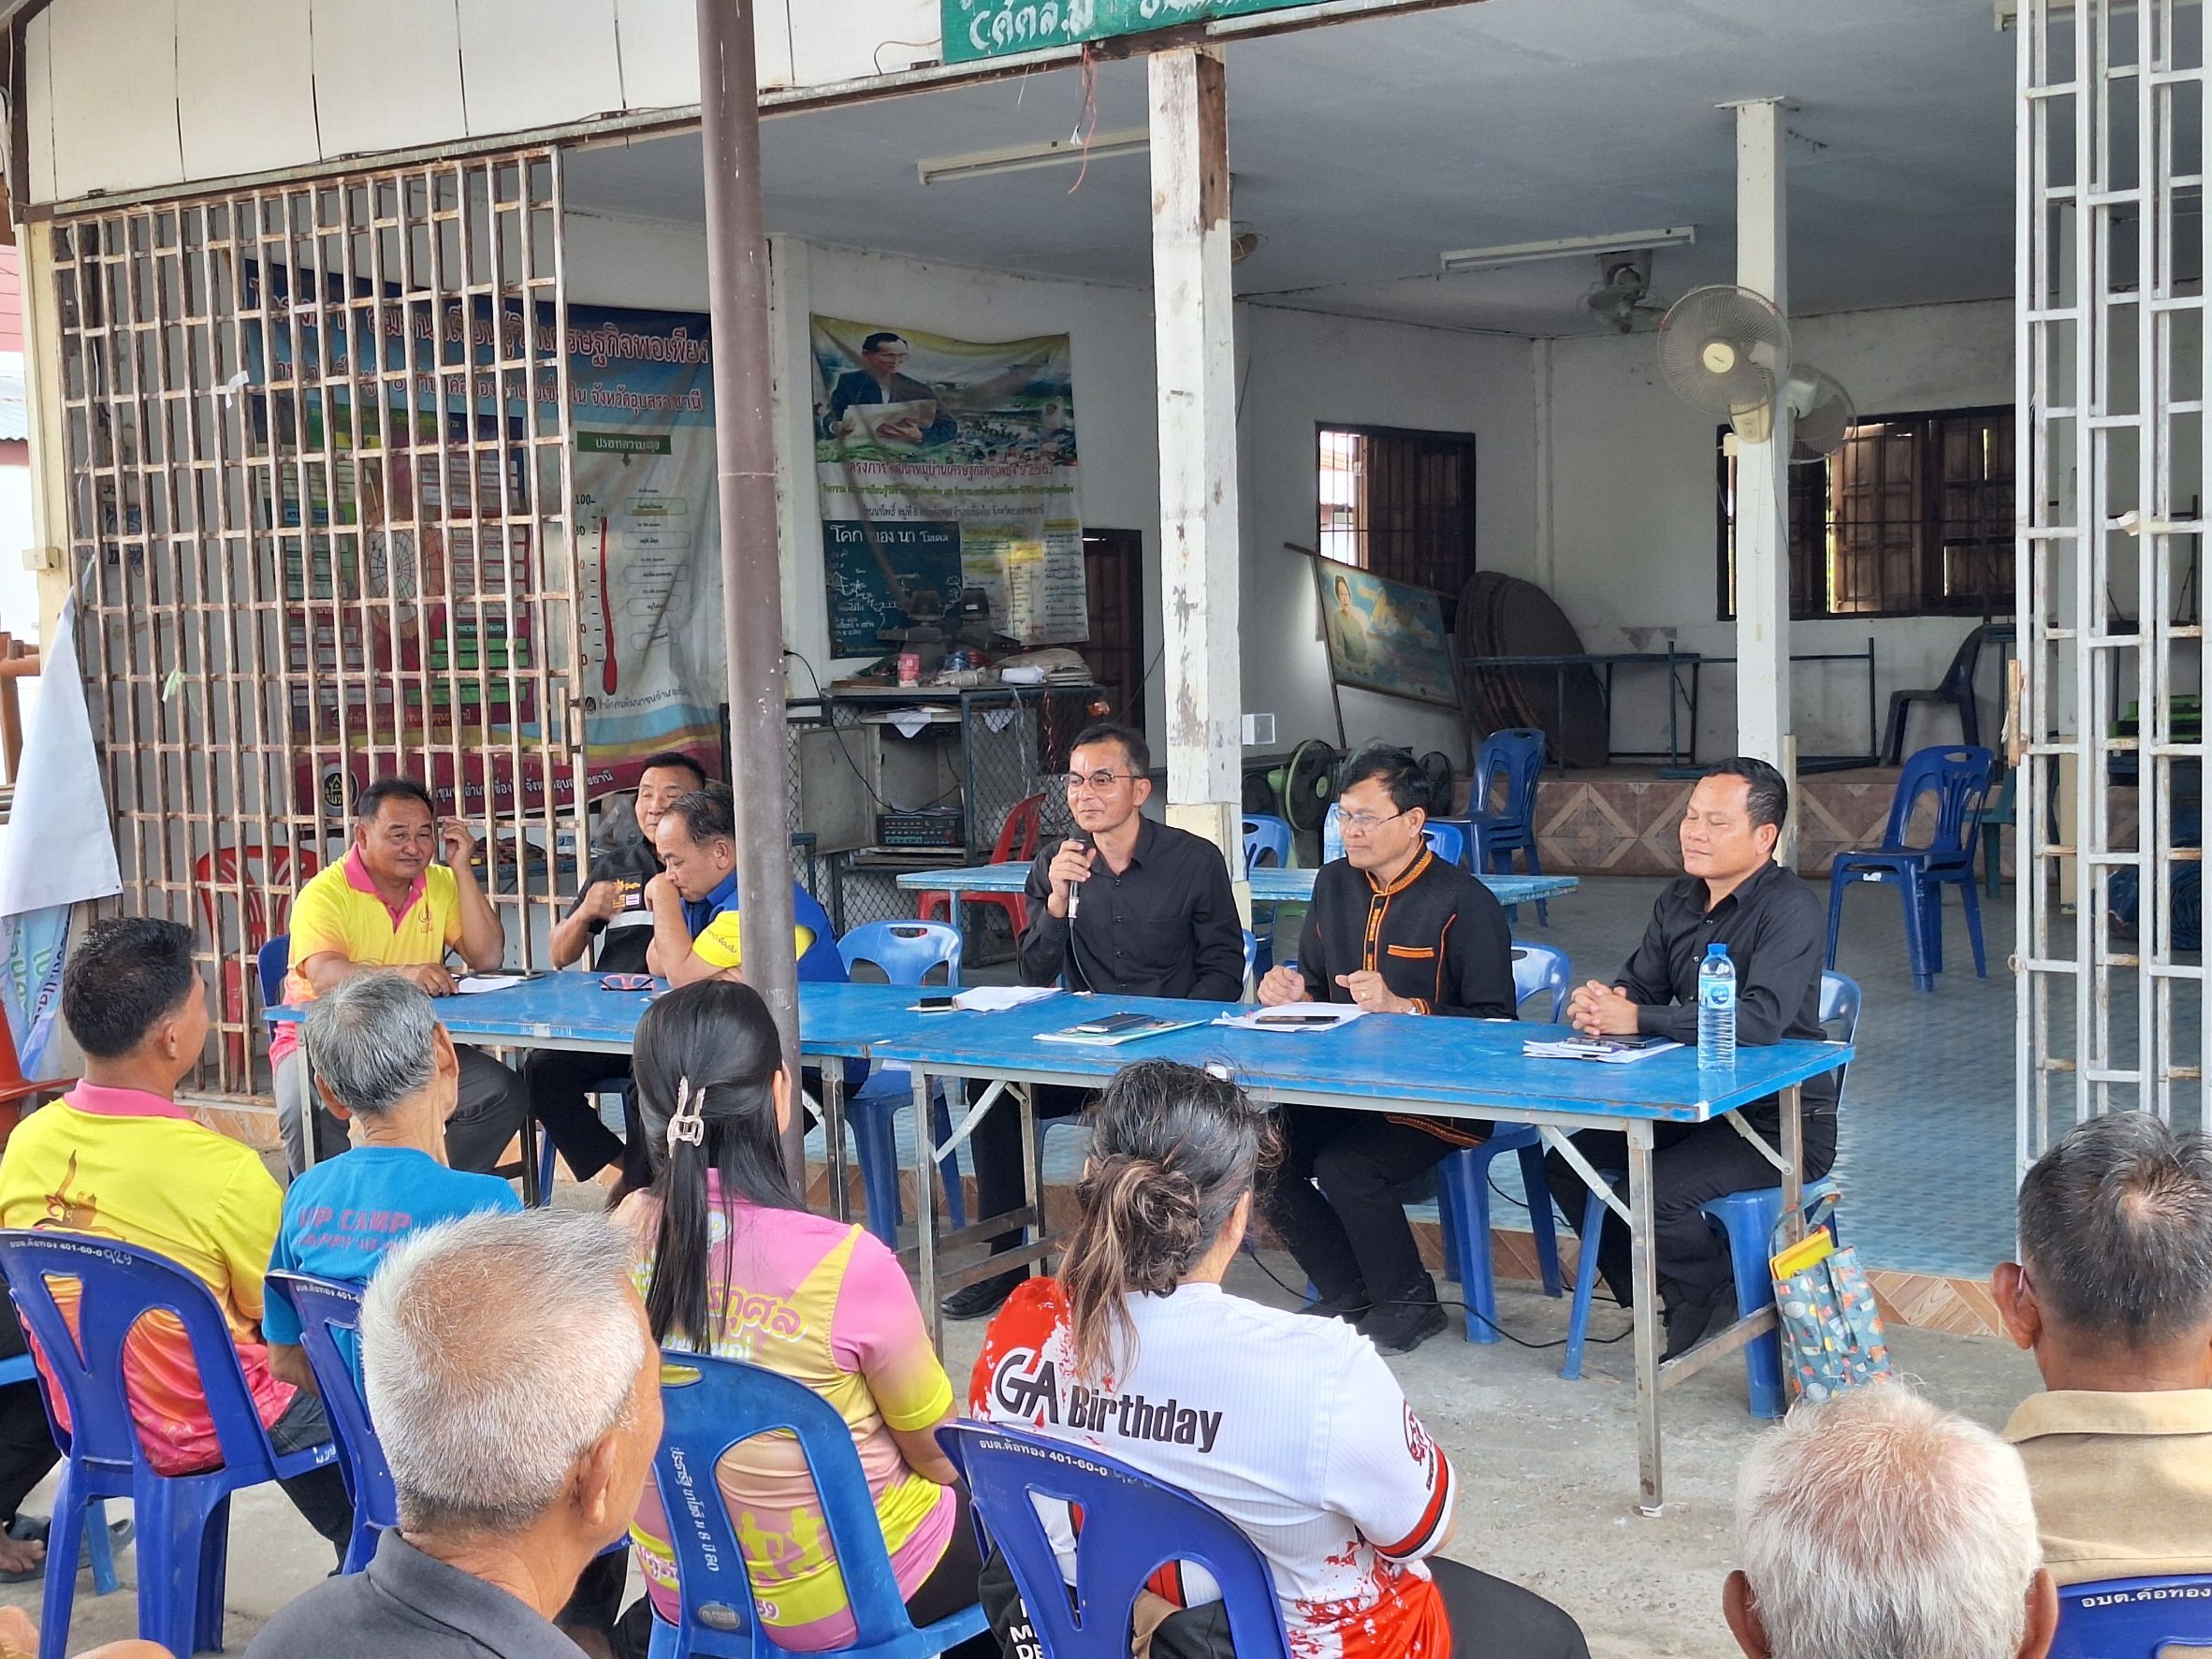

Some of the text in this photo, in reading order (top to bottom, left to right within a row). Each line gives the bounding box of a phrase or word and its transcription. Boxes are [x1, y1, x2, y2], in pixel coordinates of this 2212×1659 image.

[340, 1209, 412, 1235] CAMP
[996, 1354, 1223, 1453] GA Birthday
[1049, 1451, 1108, 1477] 401-60-0
